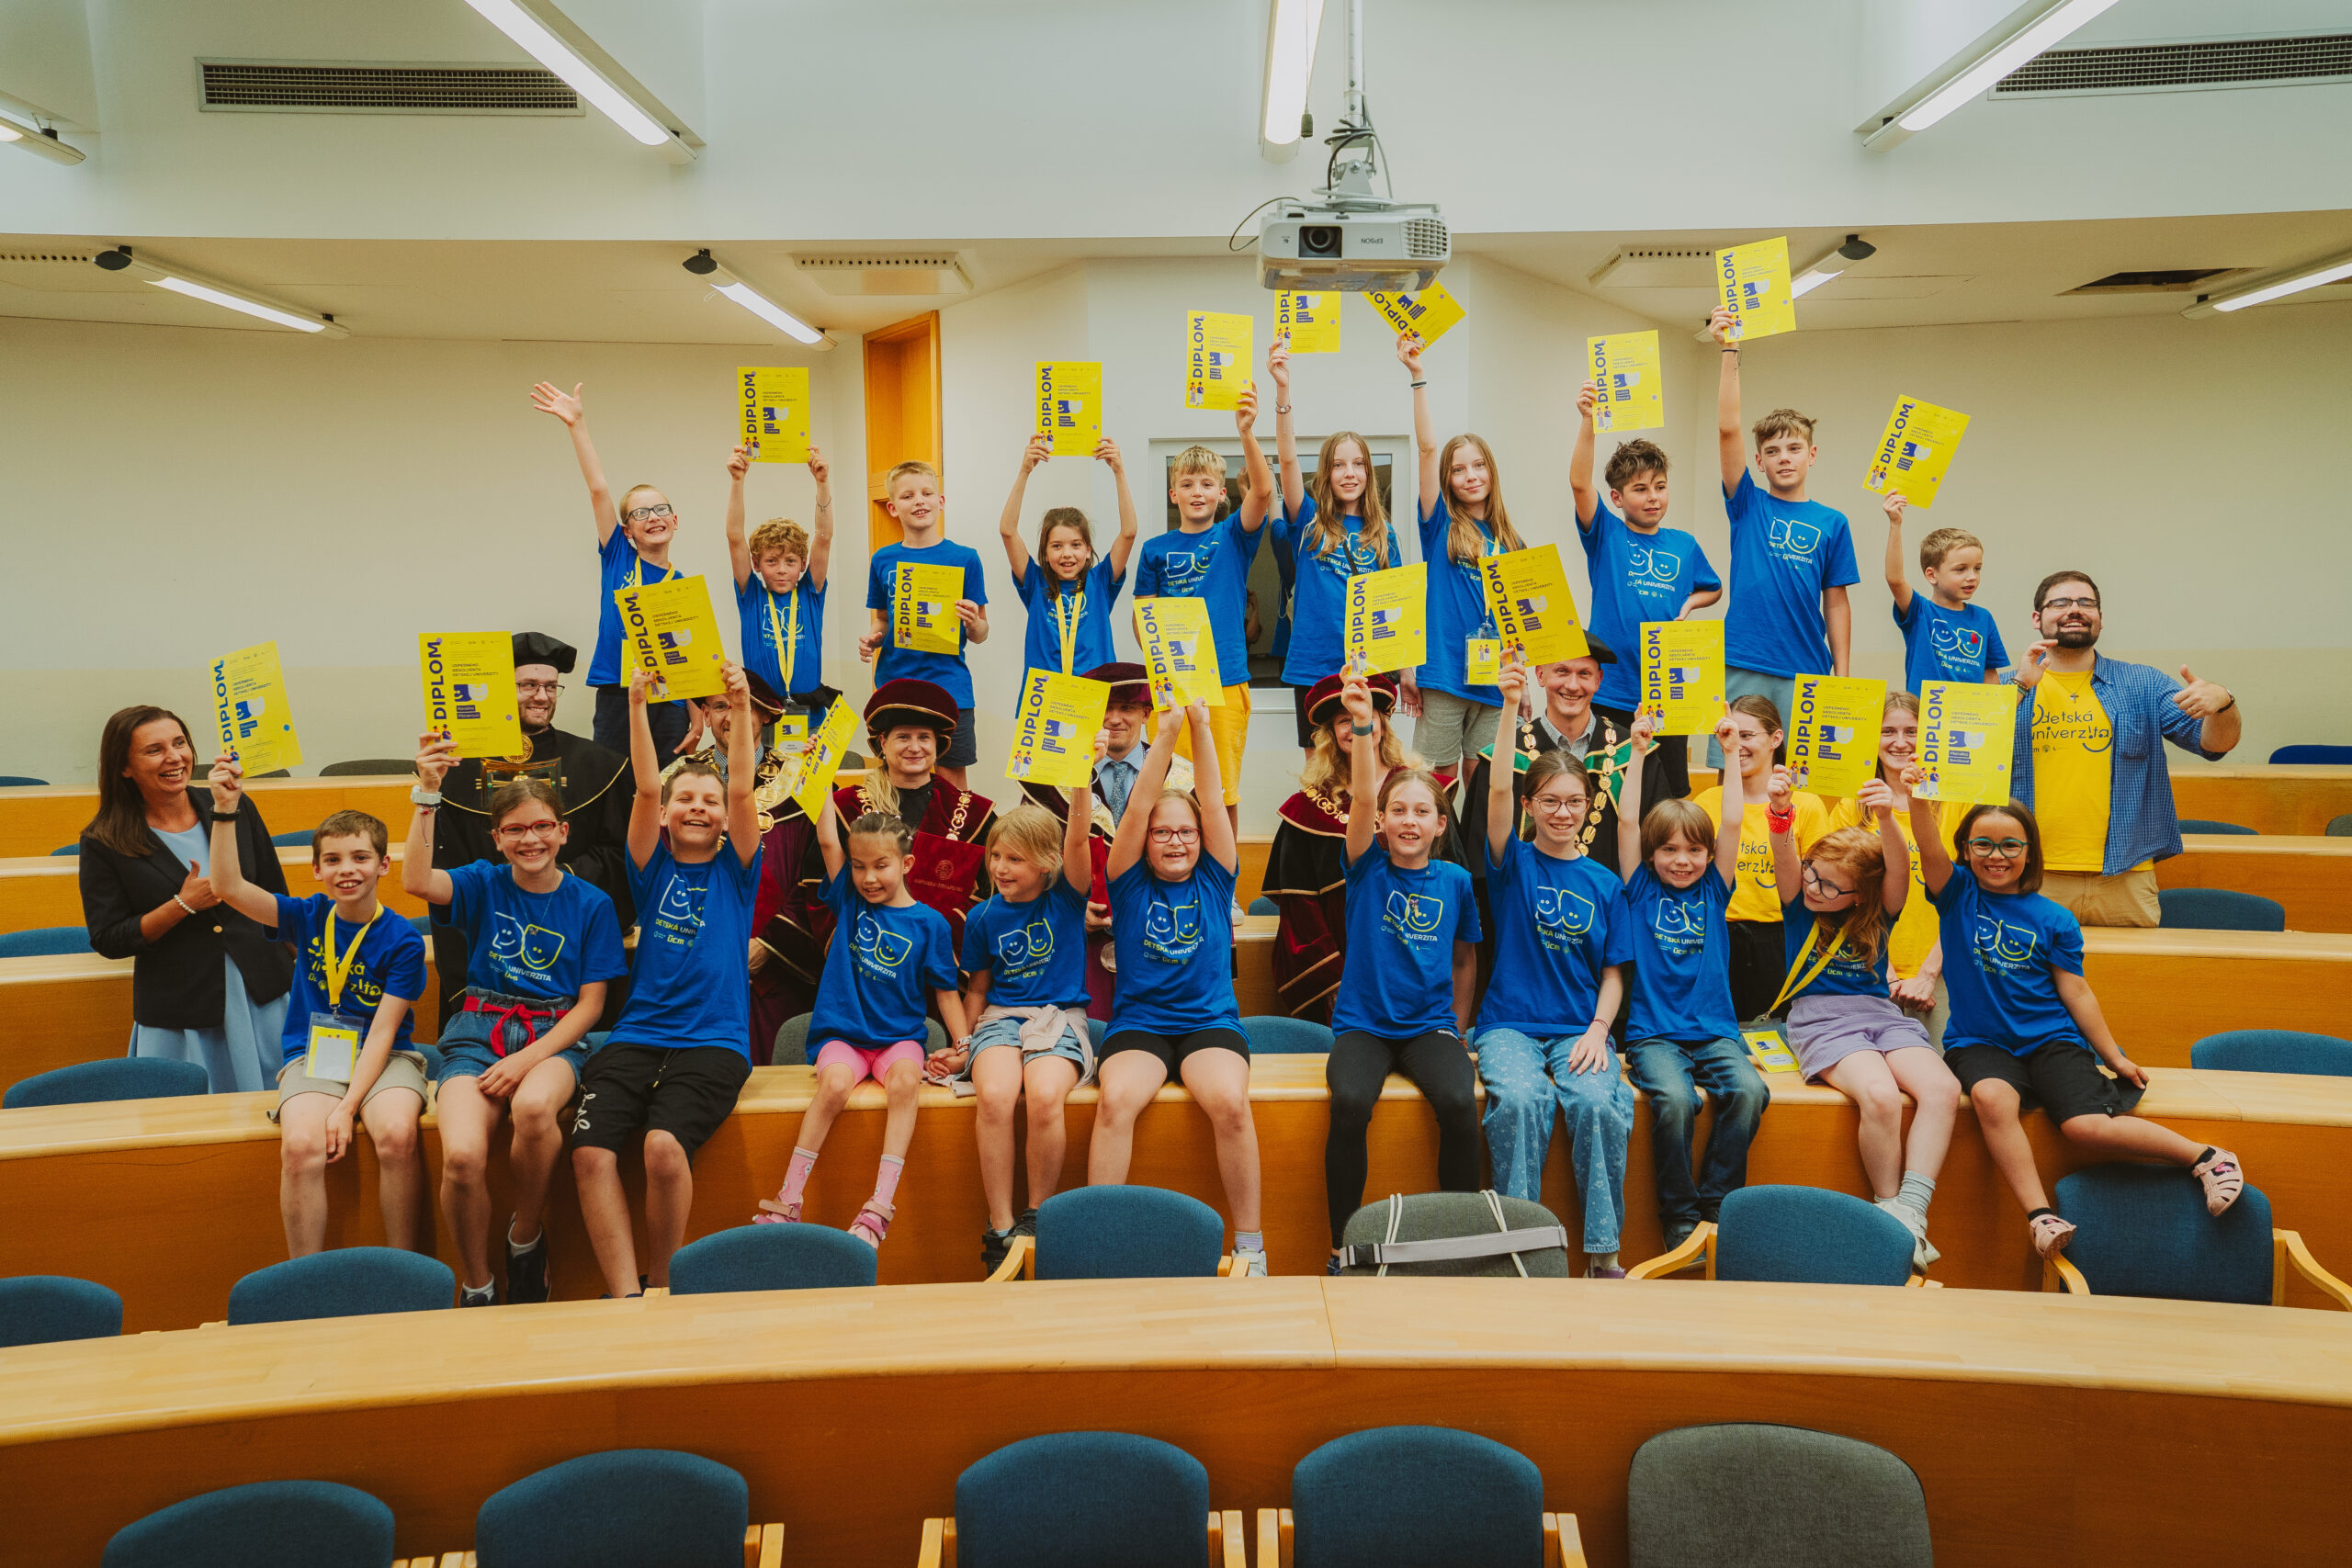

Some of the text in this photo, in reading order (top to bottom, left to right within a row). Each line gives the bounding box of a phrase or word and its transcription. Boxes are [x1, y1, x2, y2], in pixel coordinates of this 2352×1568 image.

[1280, 289, 1290, 323] DIPL
[1369, 291, 1408, 330] DIPLO
[1723, 254, 1738, 312] DIPLOM
[1193, 318, 1204, 378] DIPLOM
[1594, 343, 1608, 402] DIPLOM
[744, 374, 757, 433] DIPLOM
[1042, 368, 1051, 426] DIPLOM
[1880, 403, 1913, 464] DIPLOM
[900, 569, 912, 625] DIPLOM
[1352, 581, 1365, 643] DIPLOM
[1487, 564, 1517, 635] DIPLOM
[625, 596, 658, 667] DIPLOM
[1141, 606, 1167, 674] DIPLOM
[427, 641, 447, 719] DIPLOM
[1648, 630, 1661, 700] DIPLOM
[214, 662, 232, 742] DIPLOM
[1021, 677, 1047, 747] DIPLOM
[1795, 682, 1816, 756] DIPLOM
[1924, 689, 1944, 762] DIPLOM
[1740, 841, 1767, 854] tská
[509, 965, 551, 981] UNIVERZITA
[862, 956, 897, 978] UNIVERZITA
